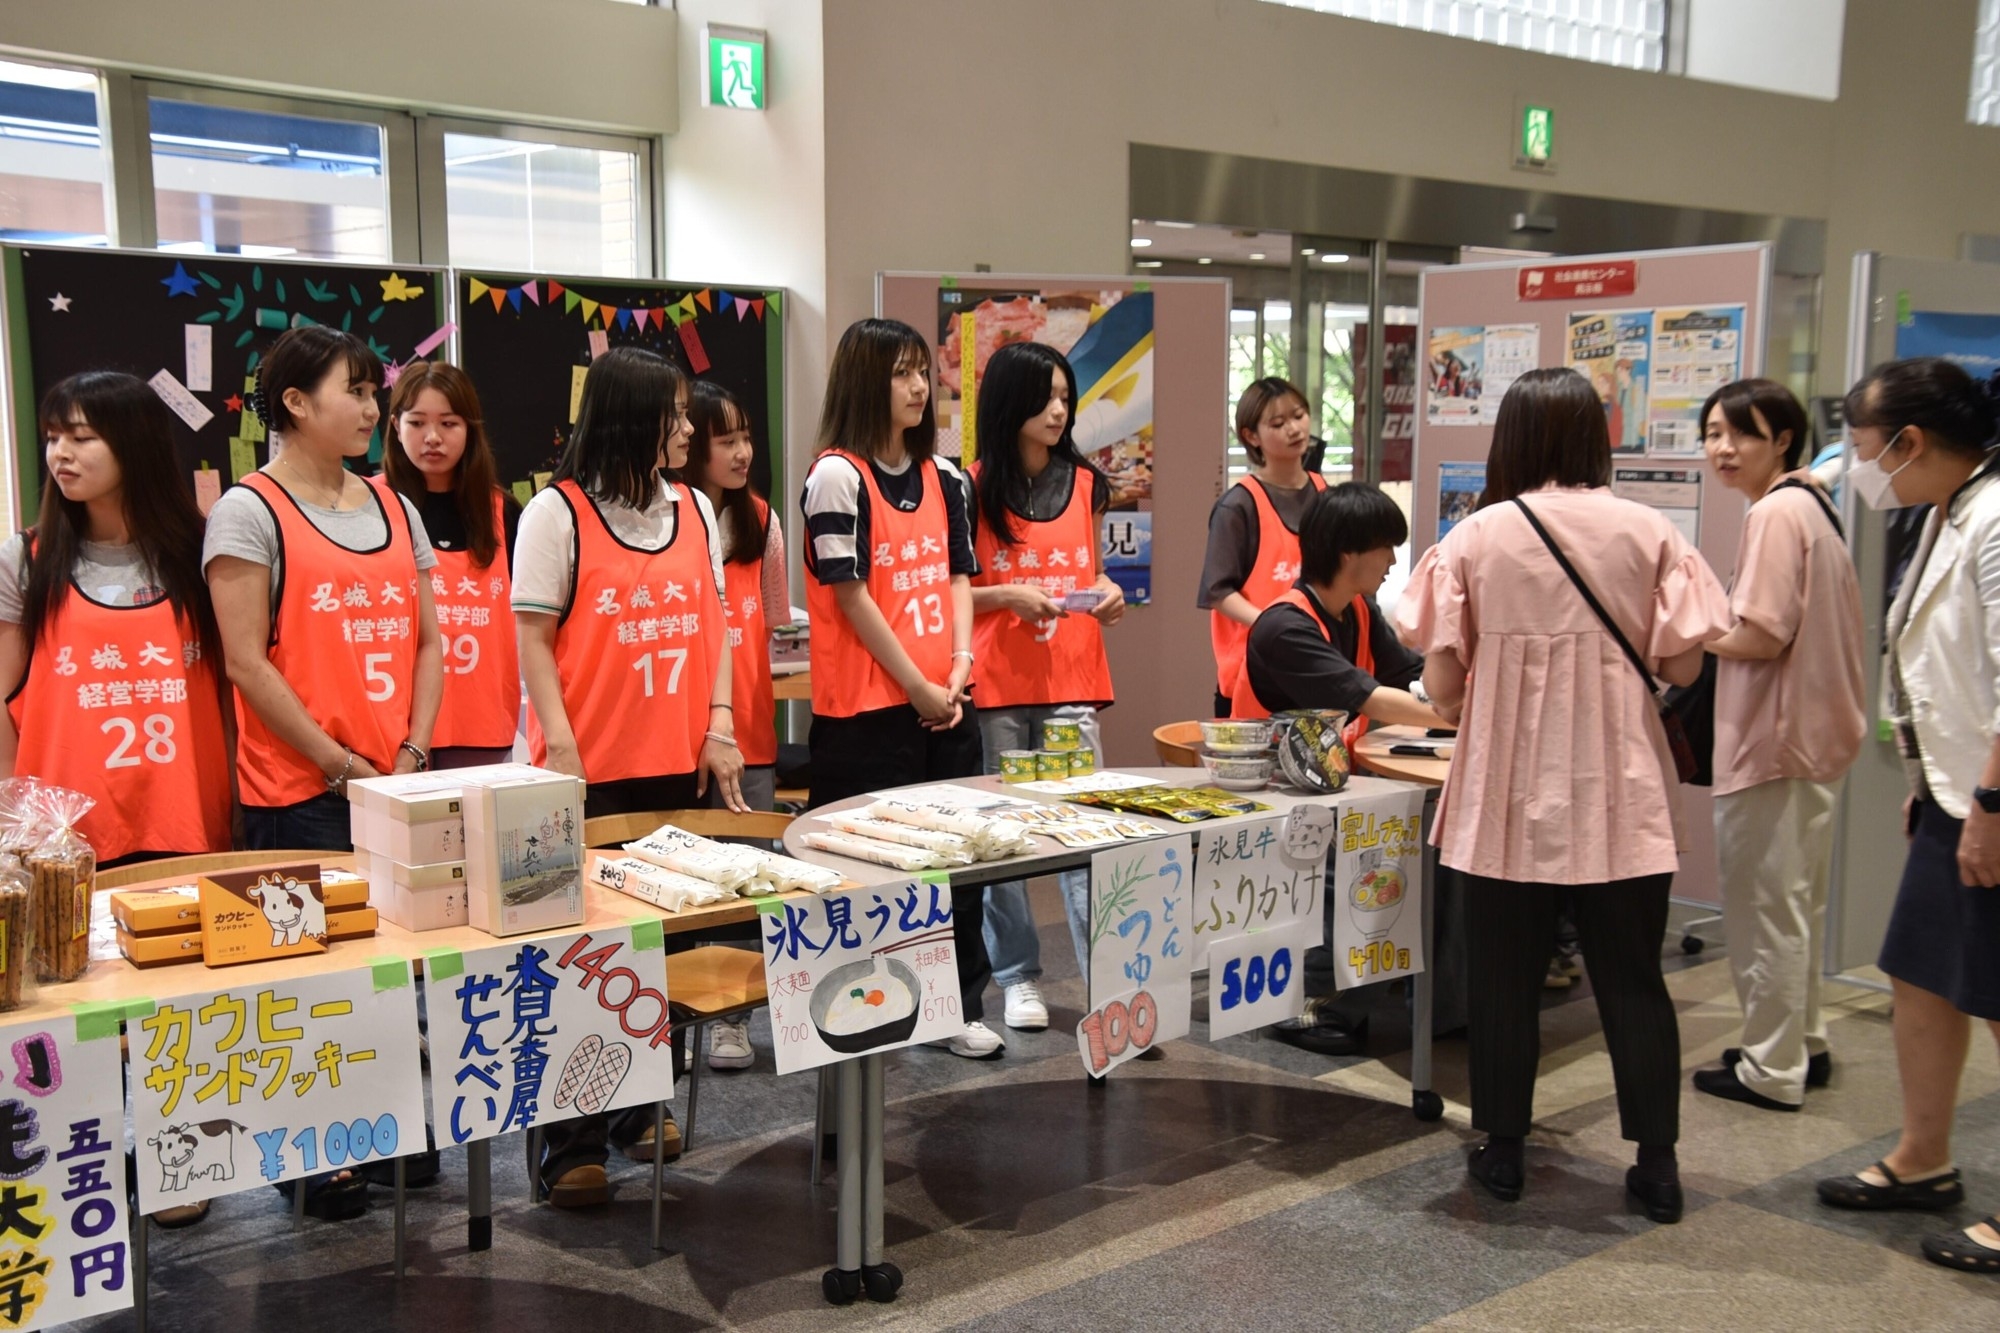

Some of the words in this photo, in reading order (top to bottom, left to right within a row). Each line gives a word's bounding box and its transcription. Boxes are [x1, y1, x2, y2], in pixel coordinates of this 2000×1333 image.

[874, 535, 948, 567] 名城大
[992, 545, 1090, 573] 名城大学
[595, 578, 700, 616] 名城大
[904, 593, 945, 637] 13
[617, 613, 699, 645] 経営学部
[77, 677, 187, 709] 経営学部
[365, 652, 396, 702] 5
[632, 648, 687, 697] 17
[100, 713, 177, 769] 28
[1208, 826, 1277, 866] 氷見牛
[1340, 807, 1421, 853] 富山ブラック
[214, 911, 255, 924] カウヒー
[1158, 847, 1184, 959] うどん
[1193, 865, 1323, 935] ふりかけ
[766, 883, 953, 967] 氷見うどん
[914, 946, 952, 972] 細麺
[1117, 909, 1152, 988] つゆ
[771, 970, 813, 1000] 太麺
[1220, 947, 1292, 1011] 500
[141, 989, 353, 1062] カウヒー
[923, 995, 958, 1022] 670
[780, 1022, 809, 1046] 700
[1081, 990, 1157, 1075] 100
[450, 974, 504, 1144] せんべい
[252, 1112, 399, 1182] ¥1000
